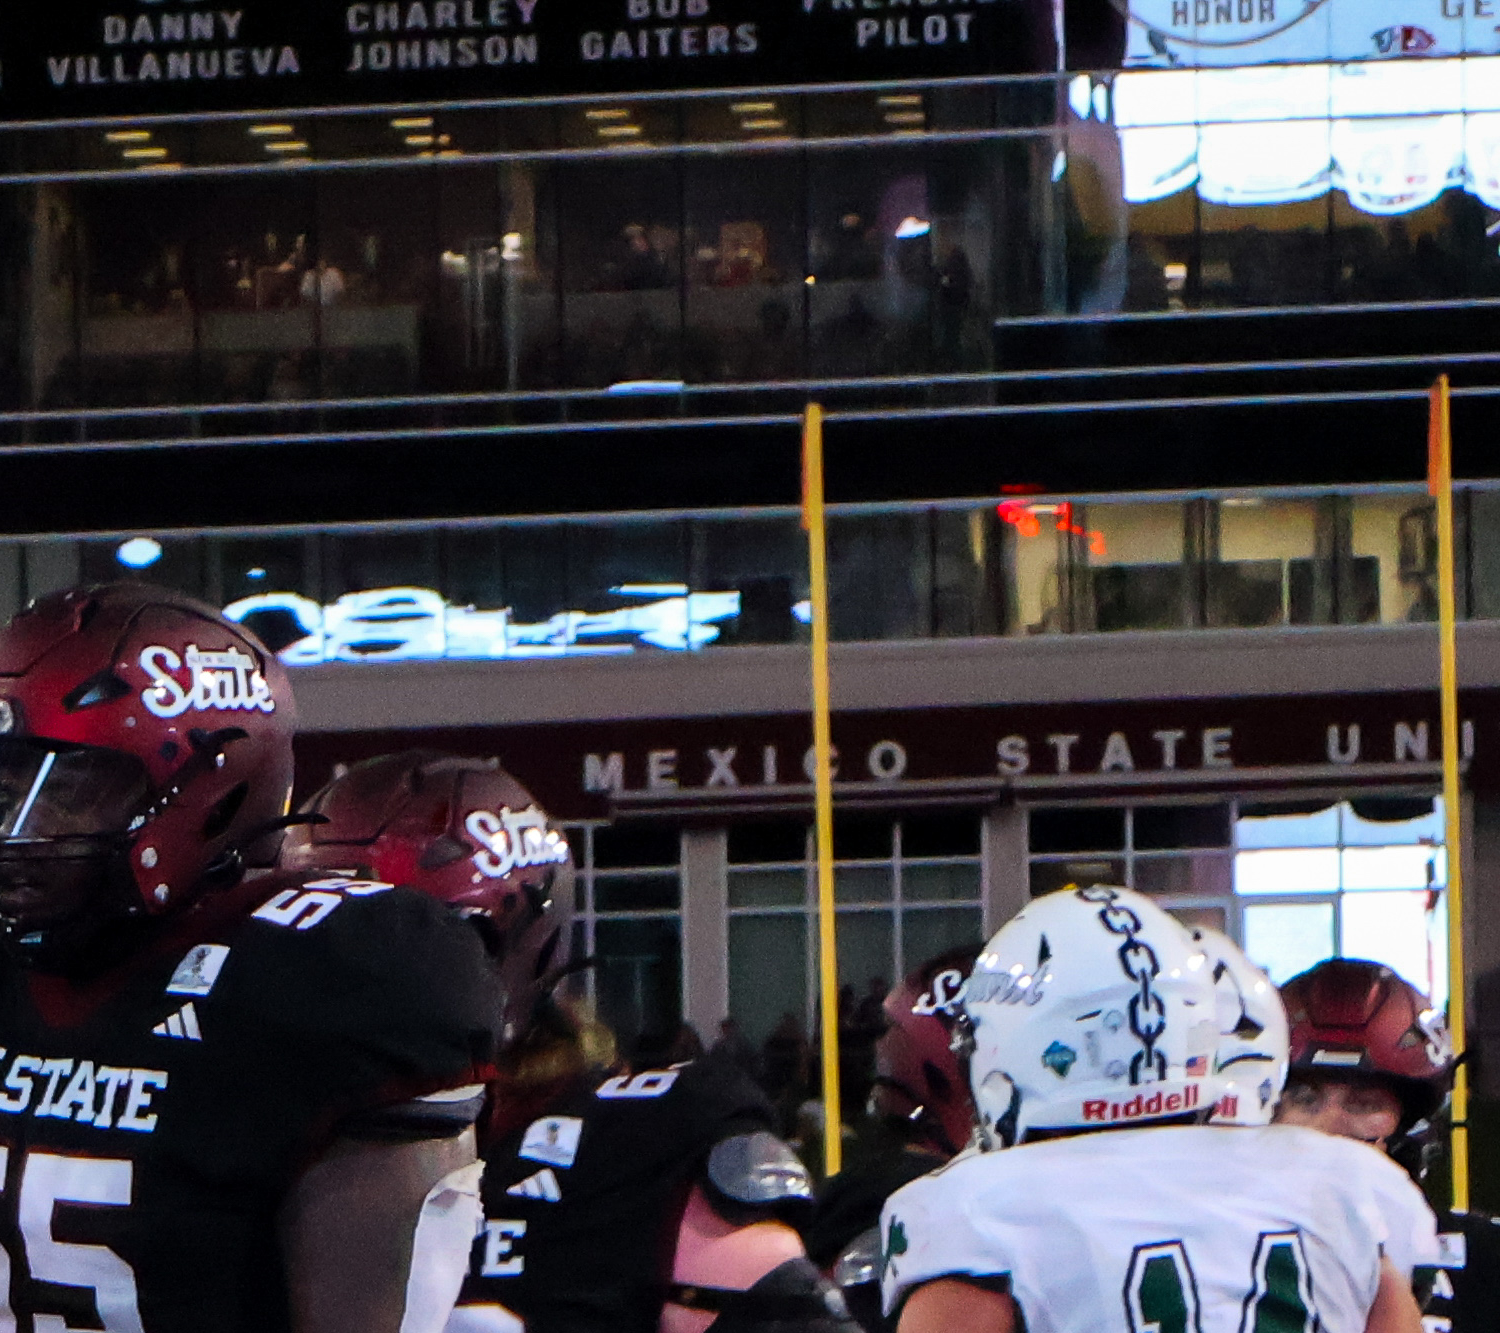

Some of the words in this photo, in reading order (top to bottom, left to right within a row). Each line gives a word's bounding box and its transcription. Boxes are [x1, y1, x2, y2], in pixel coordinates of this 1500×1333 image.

[103, 10, 243, 44] DANNY
[346, 0, 537, 32] CHARLEY
[856, 12, 976, 48] PILOT
[1172, 0, 1276, 26] HONOR
[347, 34, 538, 72] JOHNSON
[580, 22, 760, 60] GAITERS
[47, 46, 300, 85] VILLANUEVA
[139, 644, 277, 718] State
[583, 740, 908, 794] MEXICO
[997, 728, 1237, 777] STATE
[1082, 1084, 1200, 1122] Riddell
